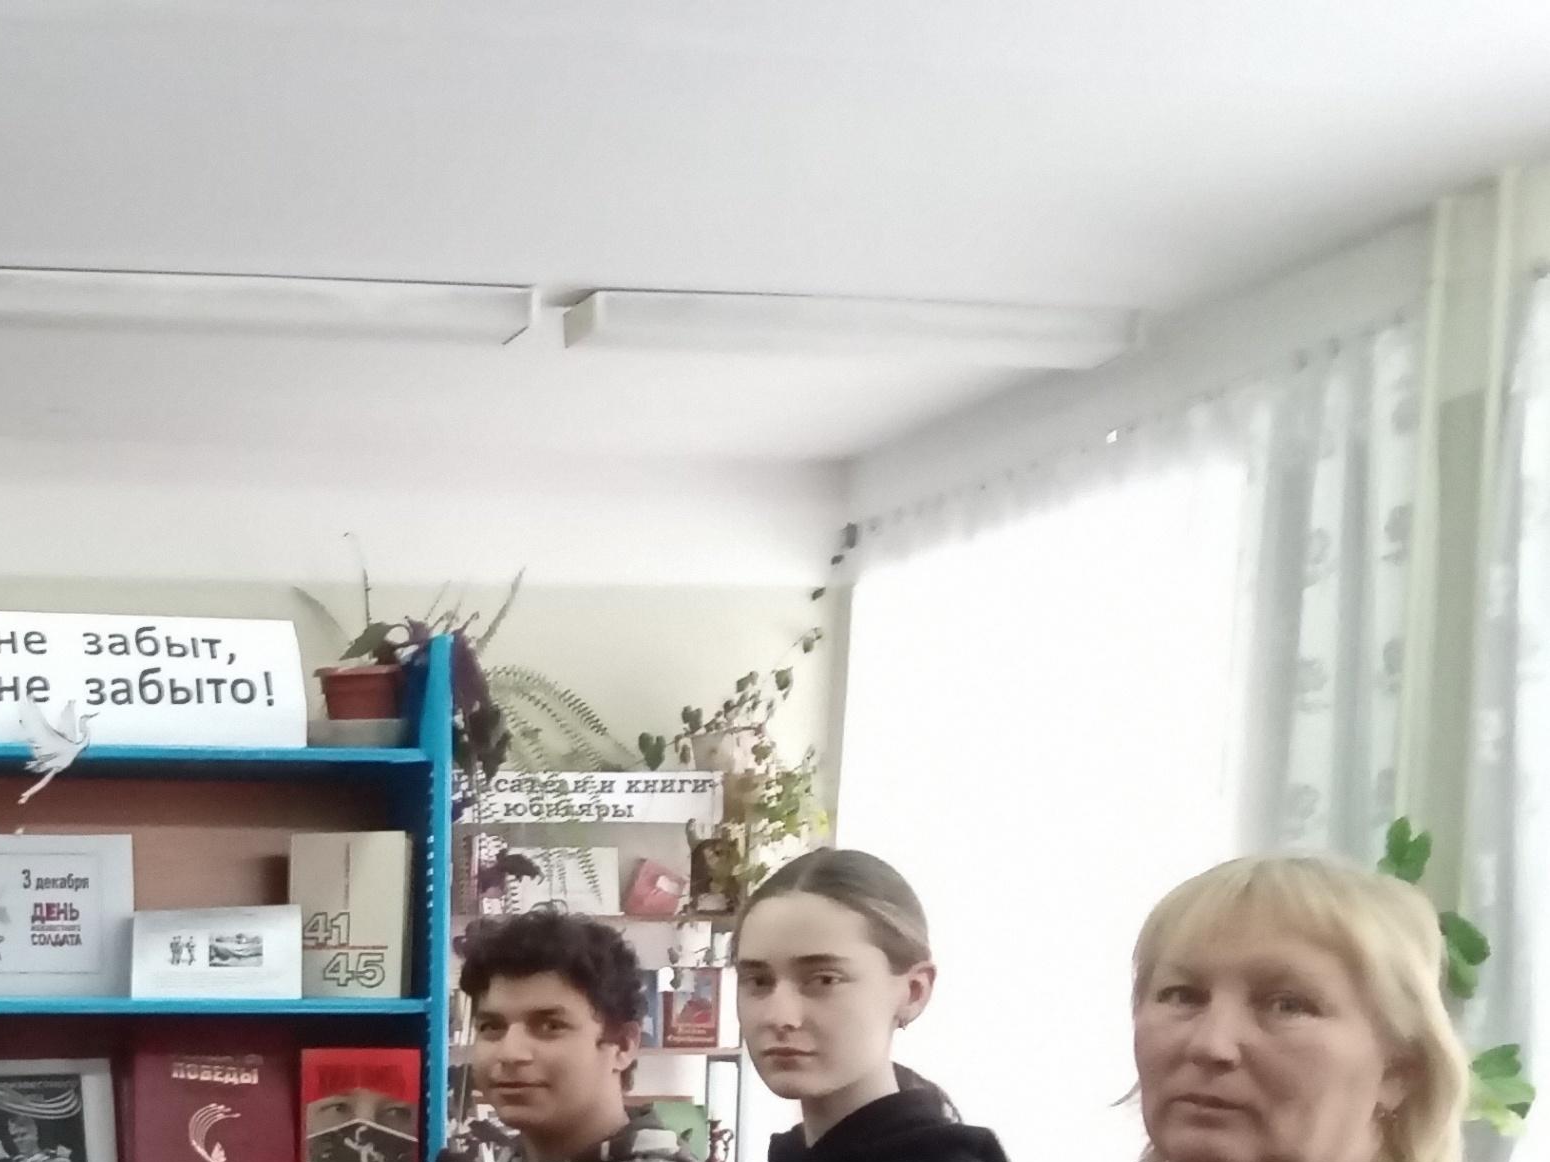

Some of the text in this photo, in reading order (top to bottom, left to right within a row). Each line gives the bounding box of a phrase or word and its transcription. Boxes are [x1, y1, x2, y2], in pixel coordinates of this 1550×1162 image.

[82, 625, 238, 665] забыт,
[85, 667, 275, 707] забыто!
[21, 868, 90, 893] 3 декабря
[30, 902, 81, 924] ДЕНЬ
[30, 933, 83, 948] СОЛДАТА
[303, 911, 351, 947] 41
[323, 952, 386, 989] 45
[171, 1062, 259, 1086] ПОБЕДЫ
